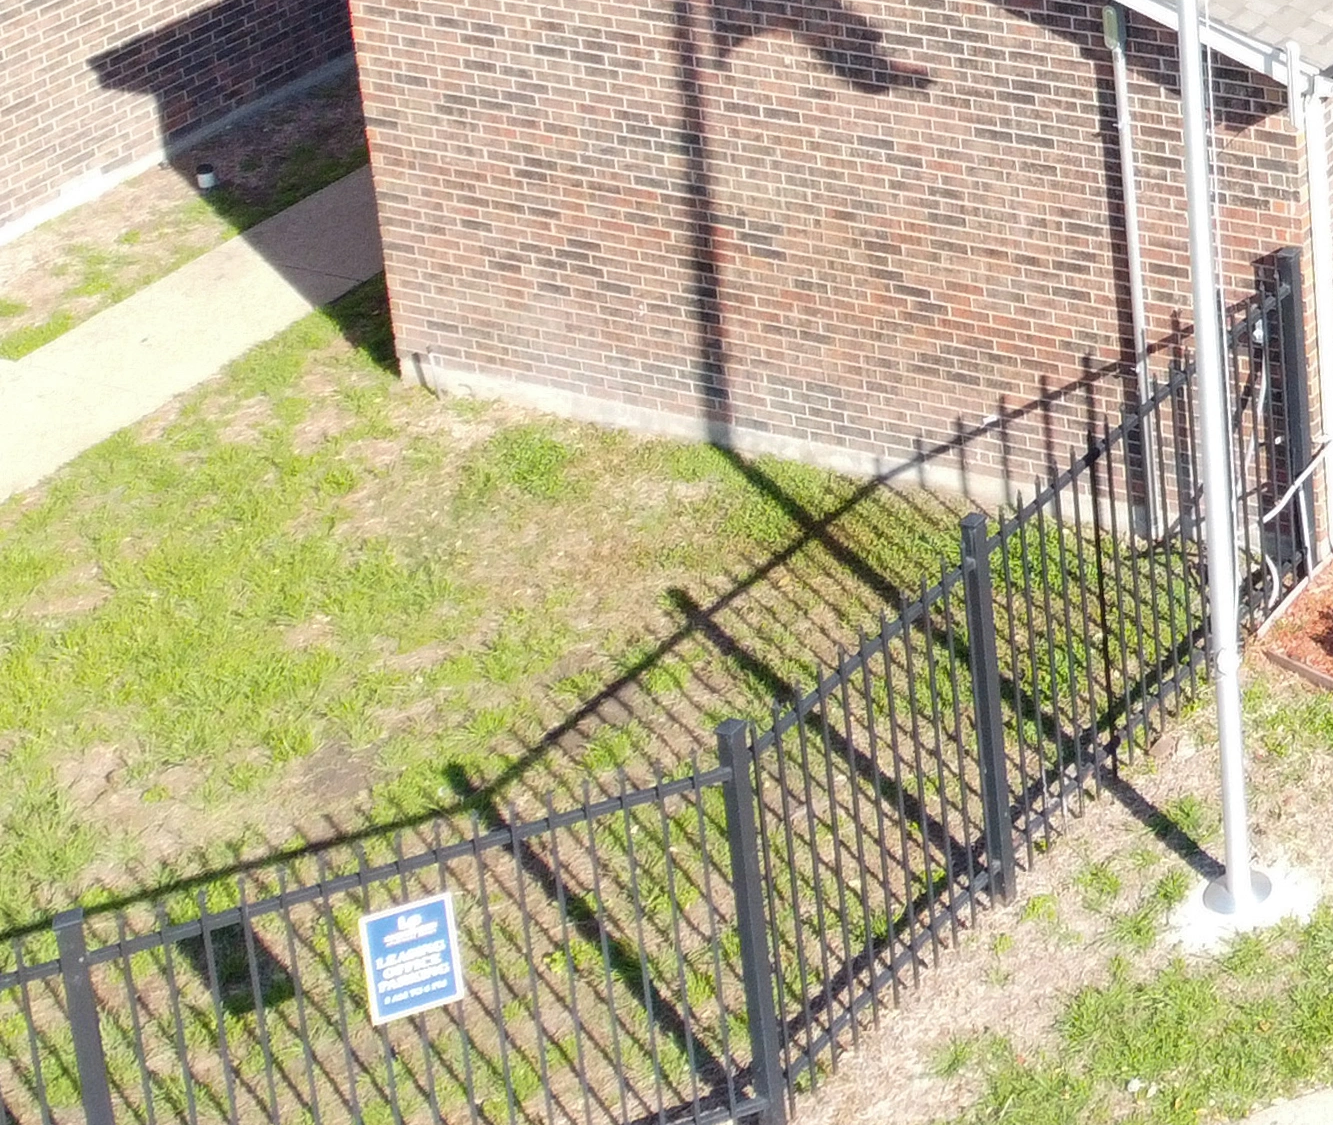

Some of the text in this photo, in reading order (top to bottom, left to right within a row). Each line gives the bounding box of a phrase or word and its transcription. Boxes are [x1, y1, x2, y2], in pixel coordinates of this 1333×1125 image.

[376, 939, 447, 970] LEASING
[382, 954, 443, 980] OFFICE
[377, 961, 451, 993] PARKING
